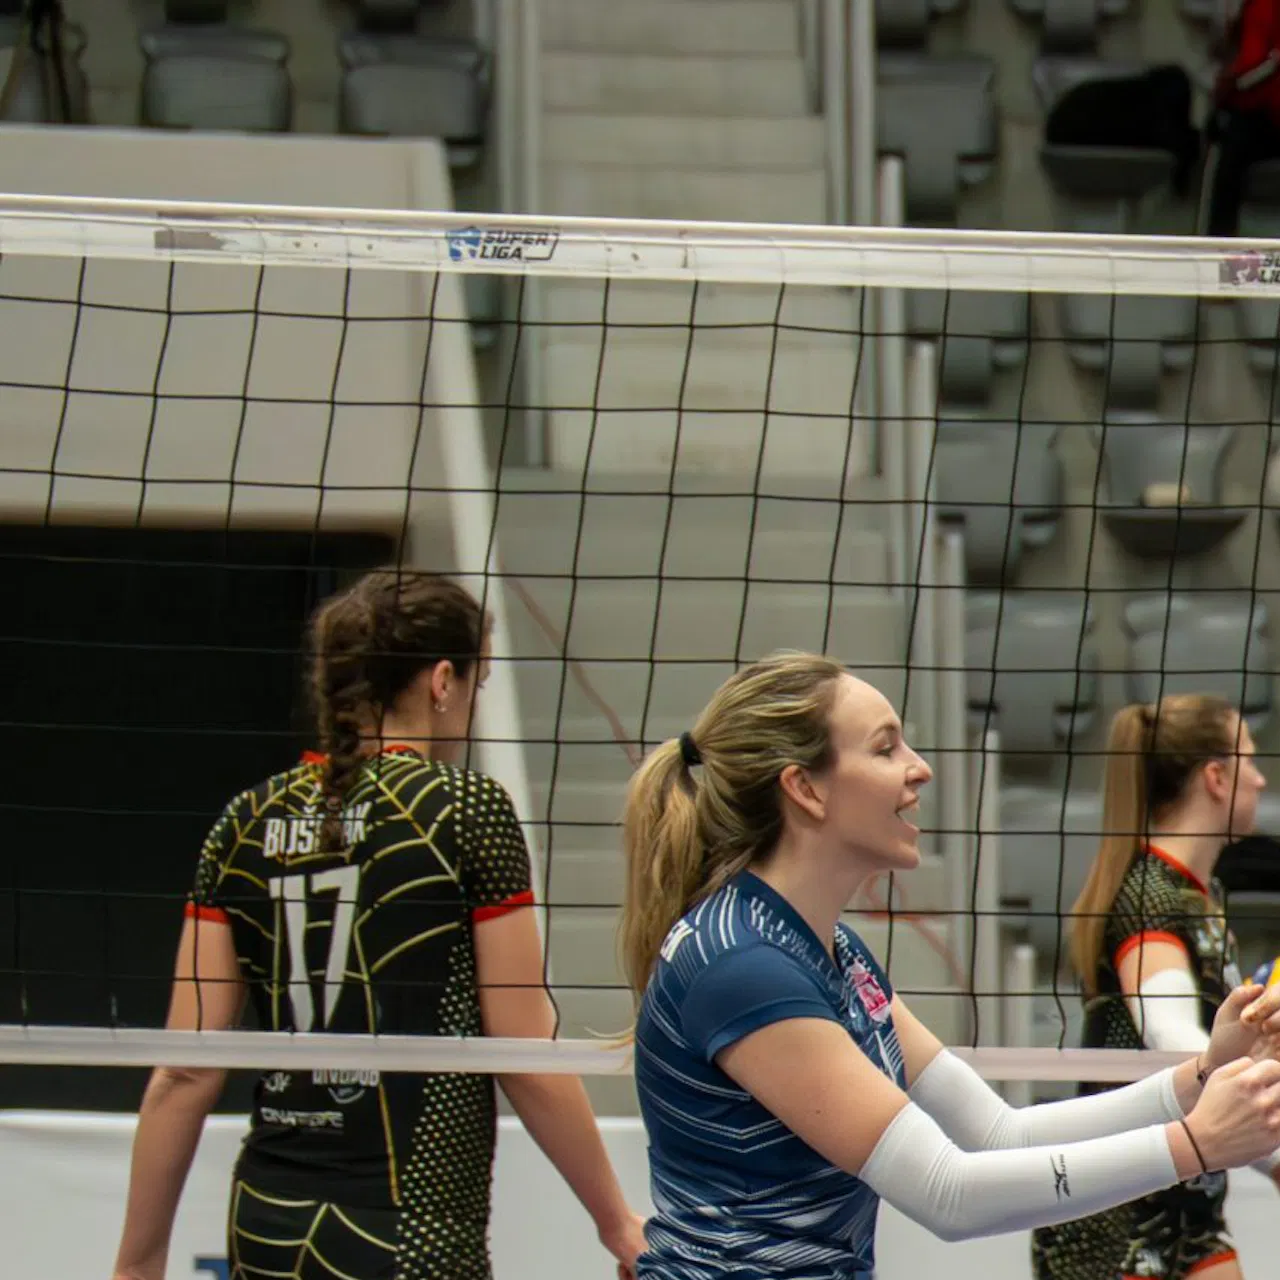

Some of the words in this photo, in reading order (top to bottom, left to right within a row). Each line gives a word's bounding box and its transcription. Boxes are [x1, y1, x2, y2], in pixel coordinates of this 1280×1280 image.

[481, 230, 549, 245] SUPER
[479, 245, 522, 260] LIGA
[268, 864, 360, 1033] 17
